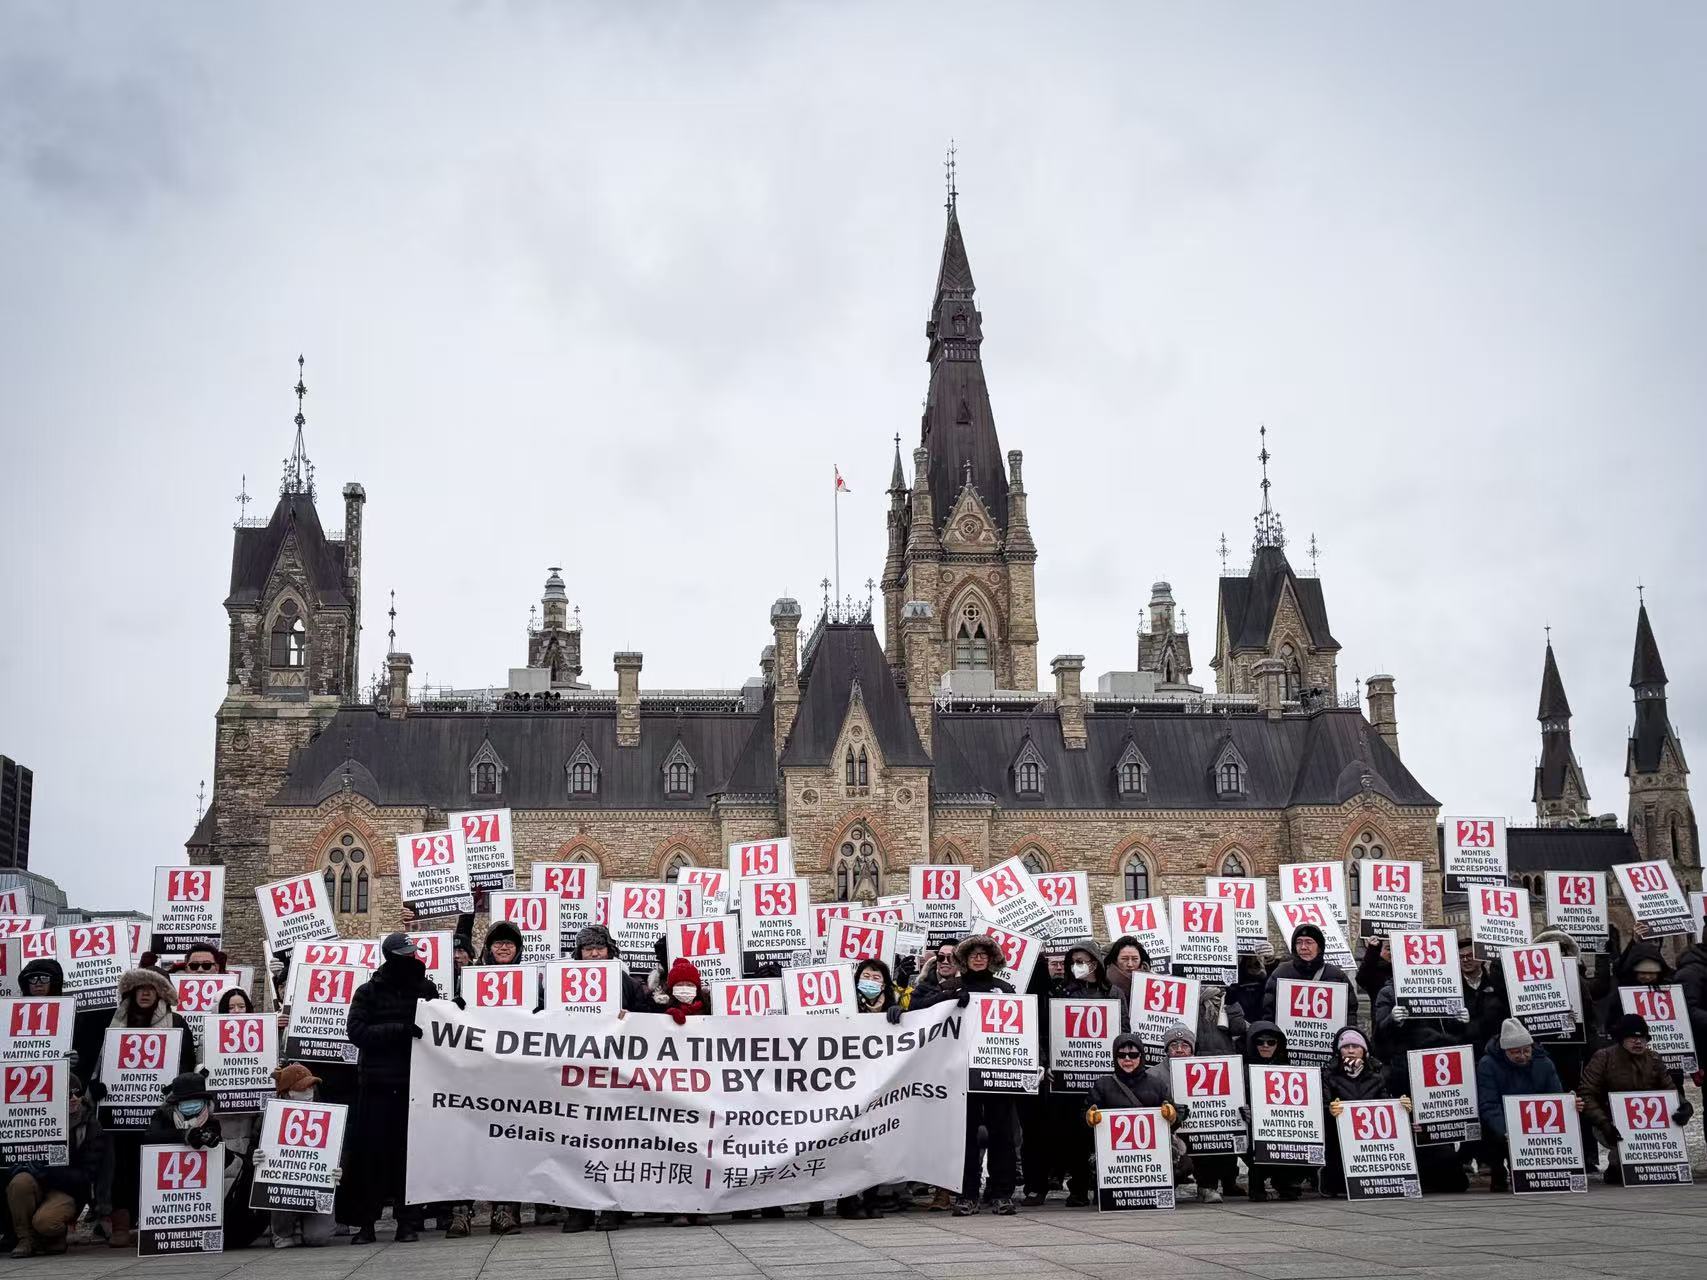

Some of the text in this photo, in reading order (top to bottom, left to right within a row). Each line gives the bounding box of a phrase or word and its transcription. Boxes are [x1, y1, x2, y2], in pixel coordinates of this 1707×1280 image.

[466, 816, 494, 842] 27
[1461, 821, 1491, 847] 25
[416, 836, 449, 866] 28
[746, 846, 773, 876] 15
[173, 871, 205, 901] 13
[410, 877, 442, 888] WAITING
[445, 875, 460, 883] FOR
[418, 868, 450, 878] MONTHS
[550, 868, 580, 898] 34
[927, 870, 955, 899] 18
[982, 868, 1019, 904] 23
[1298, 867, 1327, 892] 31
[1378, 866, 1406, 892] 15
[1633, 866, 1662, 892] 30
[276, 882, 311, 915] 34
[406, 884, 465, 897] IRCC RESPONSE
[628, 888, 660, 919] 28
[760, 884, 791, 916] 53
[1042, 878, 1074, 905] 32
[1222, 884, 1250, 908] 37
[1484, 890, 1513, 917] 15
[1562, 877, 1590, 904] 43
[508, 898, 542, 930] 40
[1122, 904, 1150, 931] 27
[1188, 902, 1217, 932] 37
[1288, 904, 1323, 926] 25
[28, 932, 56, 957] 40
[75, 927, 110, 956] 23
[686, 923, 720, 954] 71
[765, 938, 806, 946] RESPONSE
[844, 926, 878, 959] 54
[1410, 936, 1442, 964] 35
[1520, 949, 1548, 981] 19
[182, 980, 217, 1010] 39
[314, 971, 346, 1002] 31
[482, 972, 517, 1006] 31
[566, 968, 601, 1002] 38
[802, 972, 837, 1006] 90
[1150, 980, 1179, 1013] 31
[730, 986, 766, 1015] 40
[1294, 986, 1328, 1018] 46
[1639, 992, 1669, 1020] 16
[17, 1004, 50, 1035] 11
[986, 1000, 1019, 1033] 42
[1070, 1007, 1102, 1037] 70
[224, 1020, 259, 1052] 36
[431, 1016, 962, 1062] WE DEMAND A TIMELY DECISION
[986, 1037, 1020, 1045] MONTHS
[124, 1034, 160, 1068] 39
[978, 1047, 1028, 1056] WAITING FOR
[992, 1057, 1033, 1066] RESPONSE
[10, 1066, 47, 1102] 22
[561, 1065, 856, 1093] DELAYED BY IRCC
[1190, 1063, 1223, 1095] 27
[1435, 1055, 1450, 1085] 8
[1270, 1072, 1304, 1105] 36
[432, 1082, 948, 1126] REASONABLE TIMELINES PROCEDURAL FAIRNESS
[1270, 1109, 1304, 1118] MONTHS
[1526, 1101, 1560, 1133] 12
[1630, 1098, 1665, 1128] 32
[284, 1110, 324, 1147] 65
[1115, 1115, 1150, 1149] 20
[1262, 1119, 1314, 1128] WAITING FOR
[1277, 1129, 1319, 1138] RESPONSE
[1356, 1106, 1392, 1139] 30
[489, 1118, 900, 1158] Délais raisonnables Équité procédurale
[1360, 1144, 1395, 1152] MONTHS
[1520, 1148, 1554, 1156] WAITING
[1528, 1137, 1562, 1146] MONTHS
[268, 1159, 327, 1172] WAITING FOR
[280, 1149, 318, 1159] MONTHS
[1115, 1155, 1152, 1163] MONTHS
[1353, 1154, 1387, 1163] WAITING
[1369, 1163, 1412, 1172] RESPONSE
[1536, 1157, 1578, 1166] RESPONSE
[1644, 1151, 1683, 1159] RESPONSE
[162, 1152, 202, 1188] 42
[261, 1170, 331, 1183] IRCC RESPONSE
[584, 1158, 826, 1189] 给出时限 程序公平
[1104, 1174, 1167, 1184] IRCC RESPONSE
[1108, 1164, 1162, 1174] WAITING FOR
[162, 1192, 201, 1202] MONTHS
[267, 1186, 278, 1194] NO
[282, 1197, 314, 1206] RESULTS
[146, 1214, 216, 1226] IRCC RESPONSE
[152, 1203, 212, 1214] WAITING FOR
[157, 1240, 203, 1249] NO RESULTS
